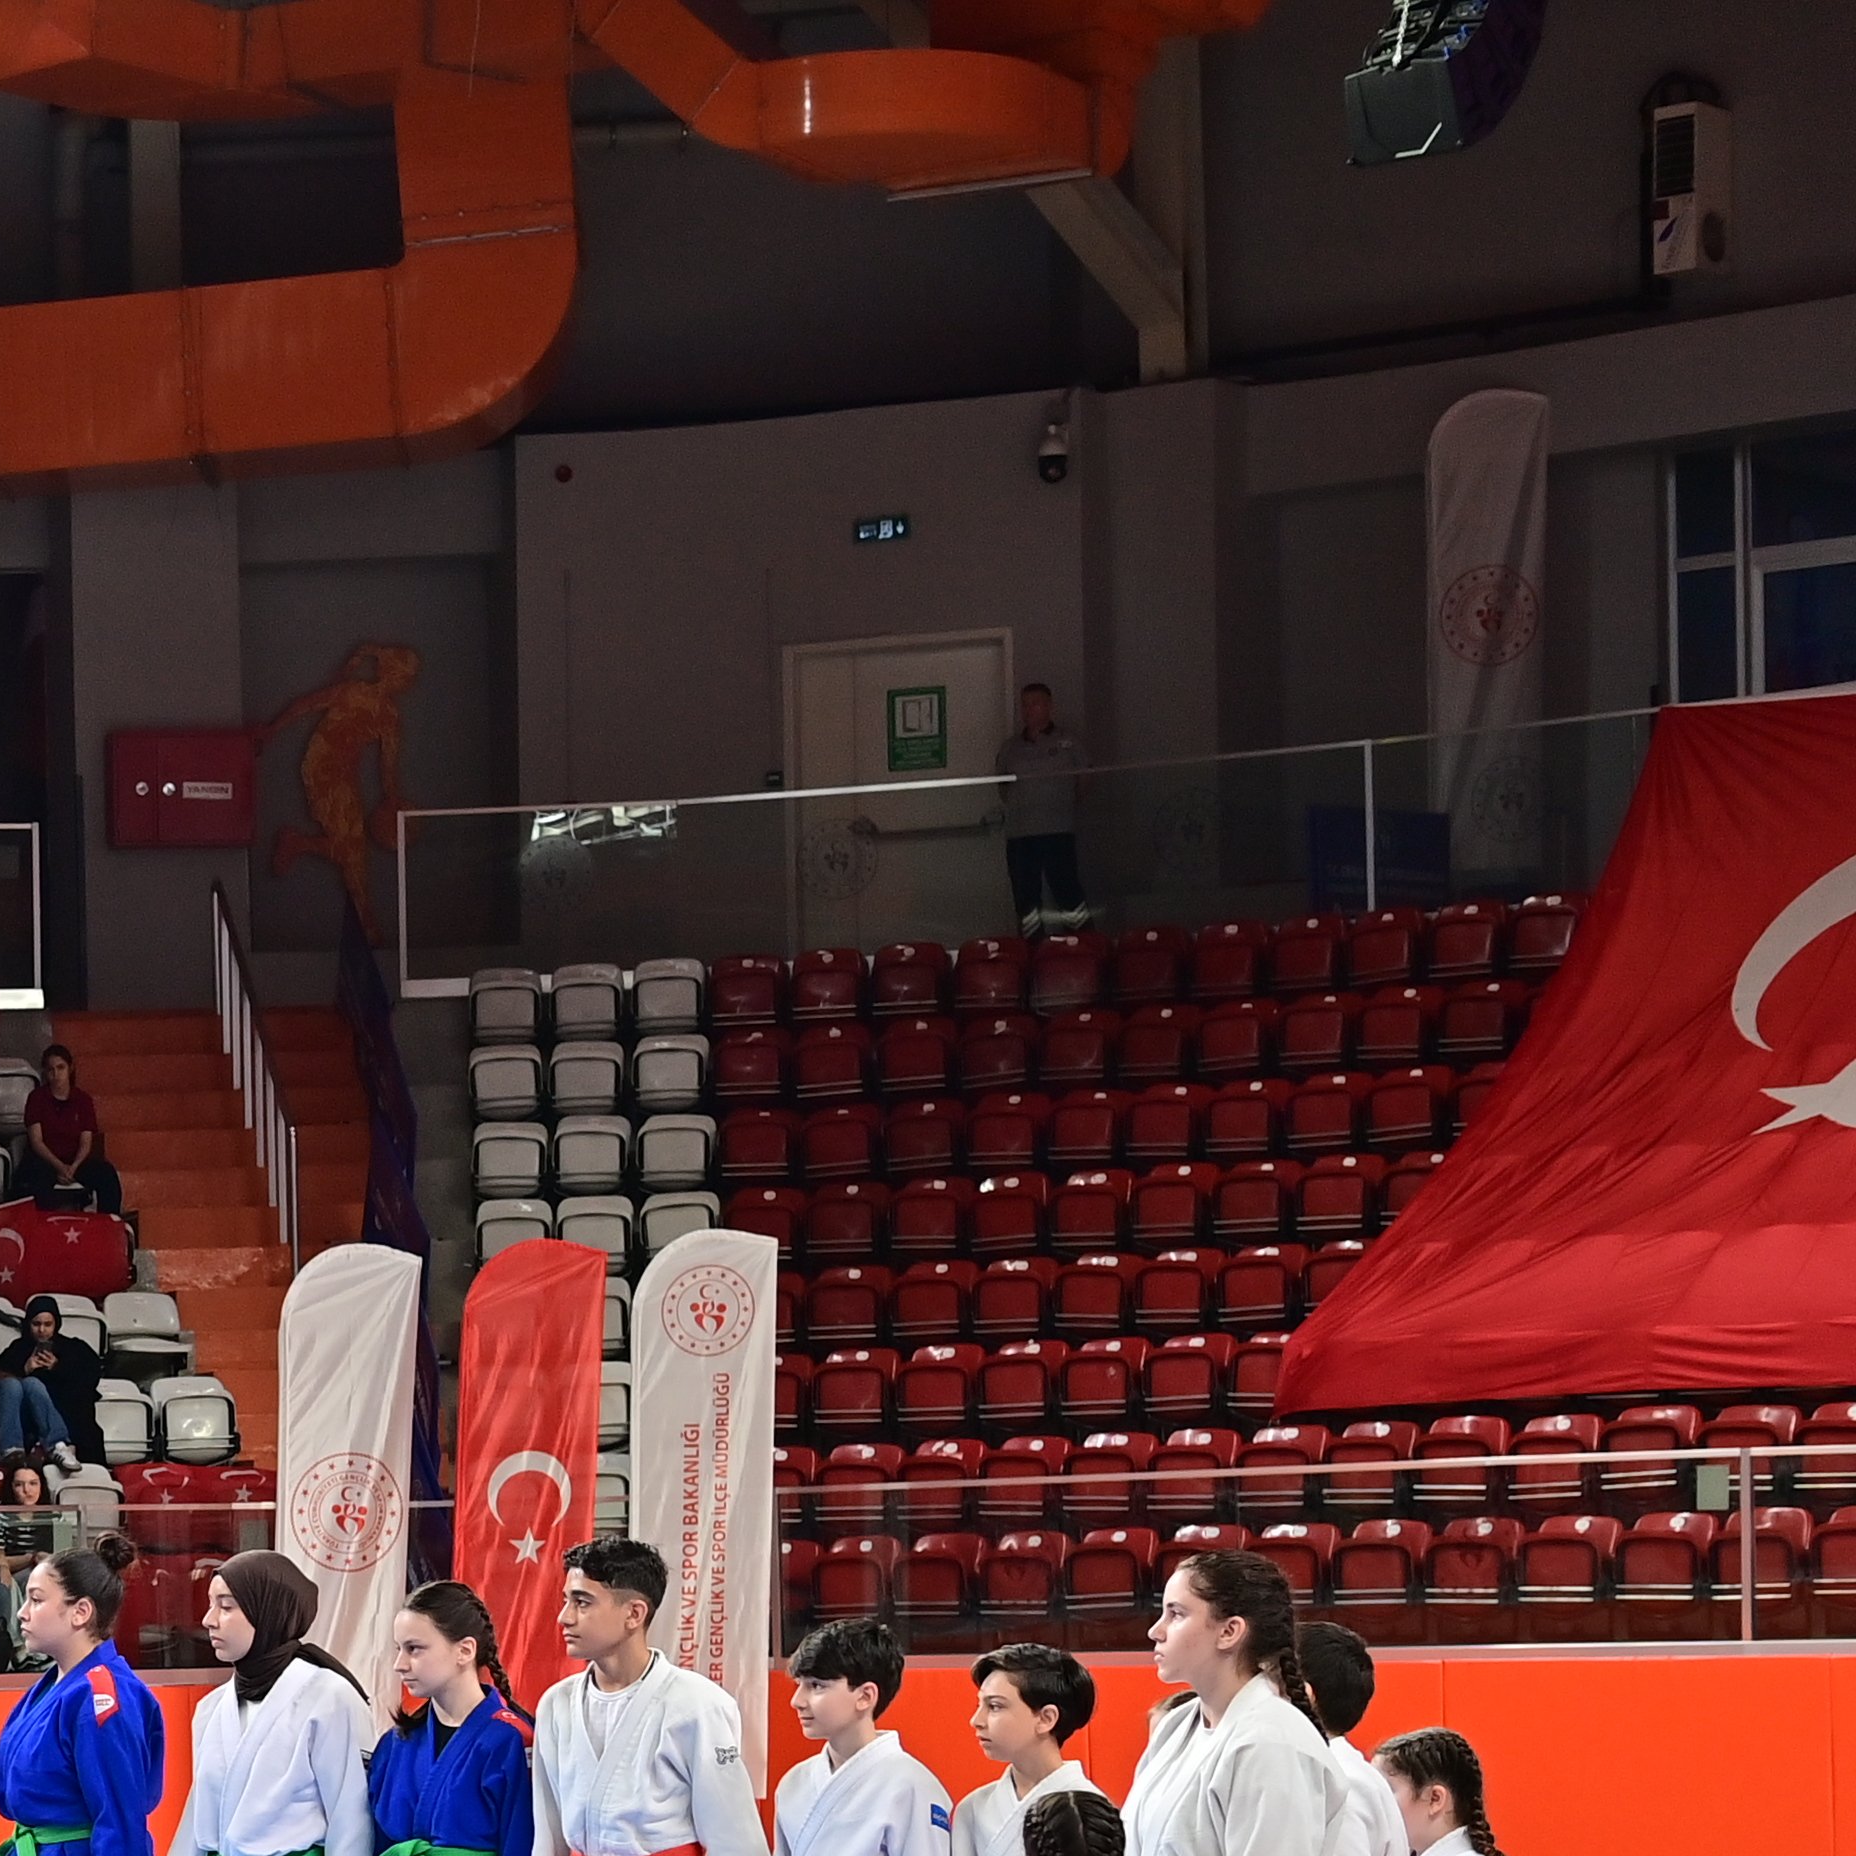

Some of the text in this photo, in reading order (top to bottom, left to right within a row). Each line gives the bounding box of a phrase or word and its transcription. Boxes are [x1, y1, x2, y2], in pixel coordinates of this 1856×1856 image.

[711, 1373, 730, 1478] MÜDÜRLÜĞÜ
[680, 1424, 700, 1525] BAKANLIĞI
[713, 1482, 731, 1517] İLÇE
[682, 1532, 698, 1580] SPOR
[712, 1520, 726, 1561] SPOR
[681, 1585, 697, 1609] VE
[711, 1566, 725, 1592] VE
[709, 1592, 728, 1658] GENÇLİK
